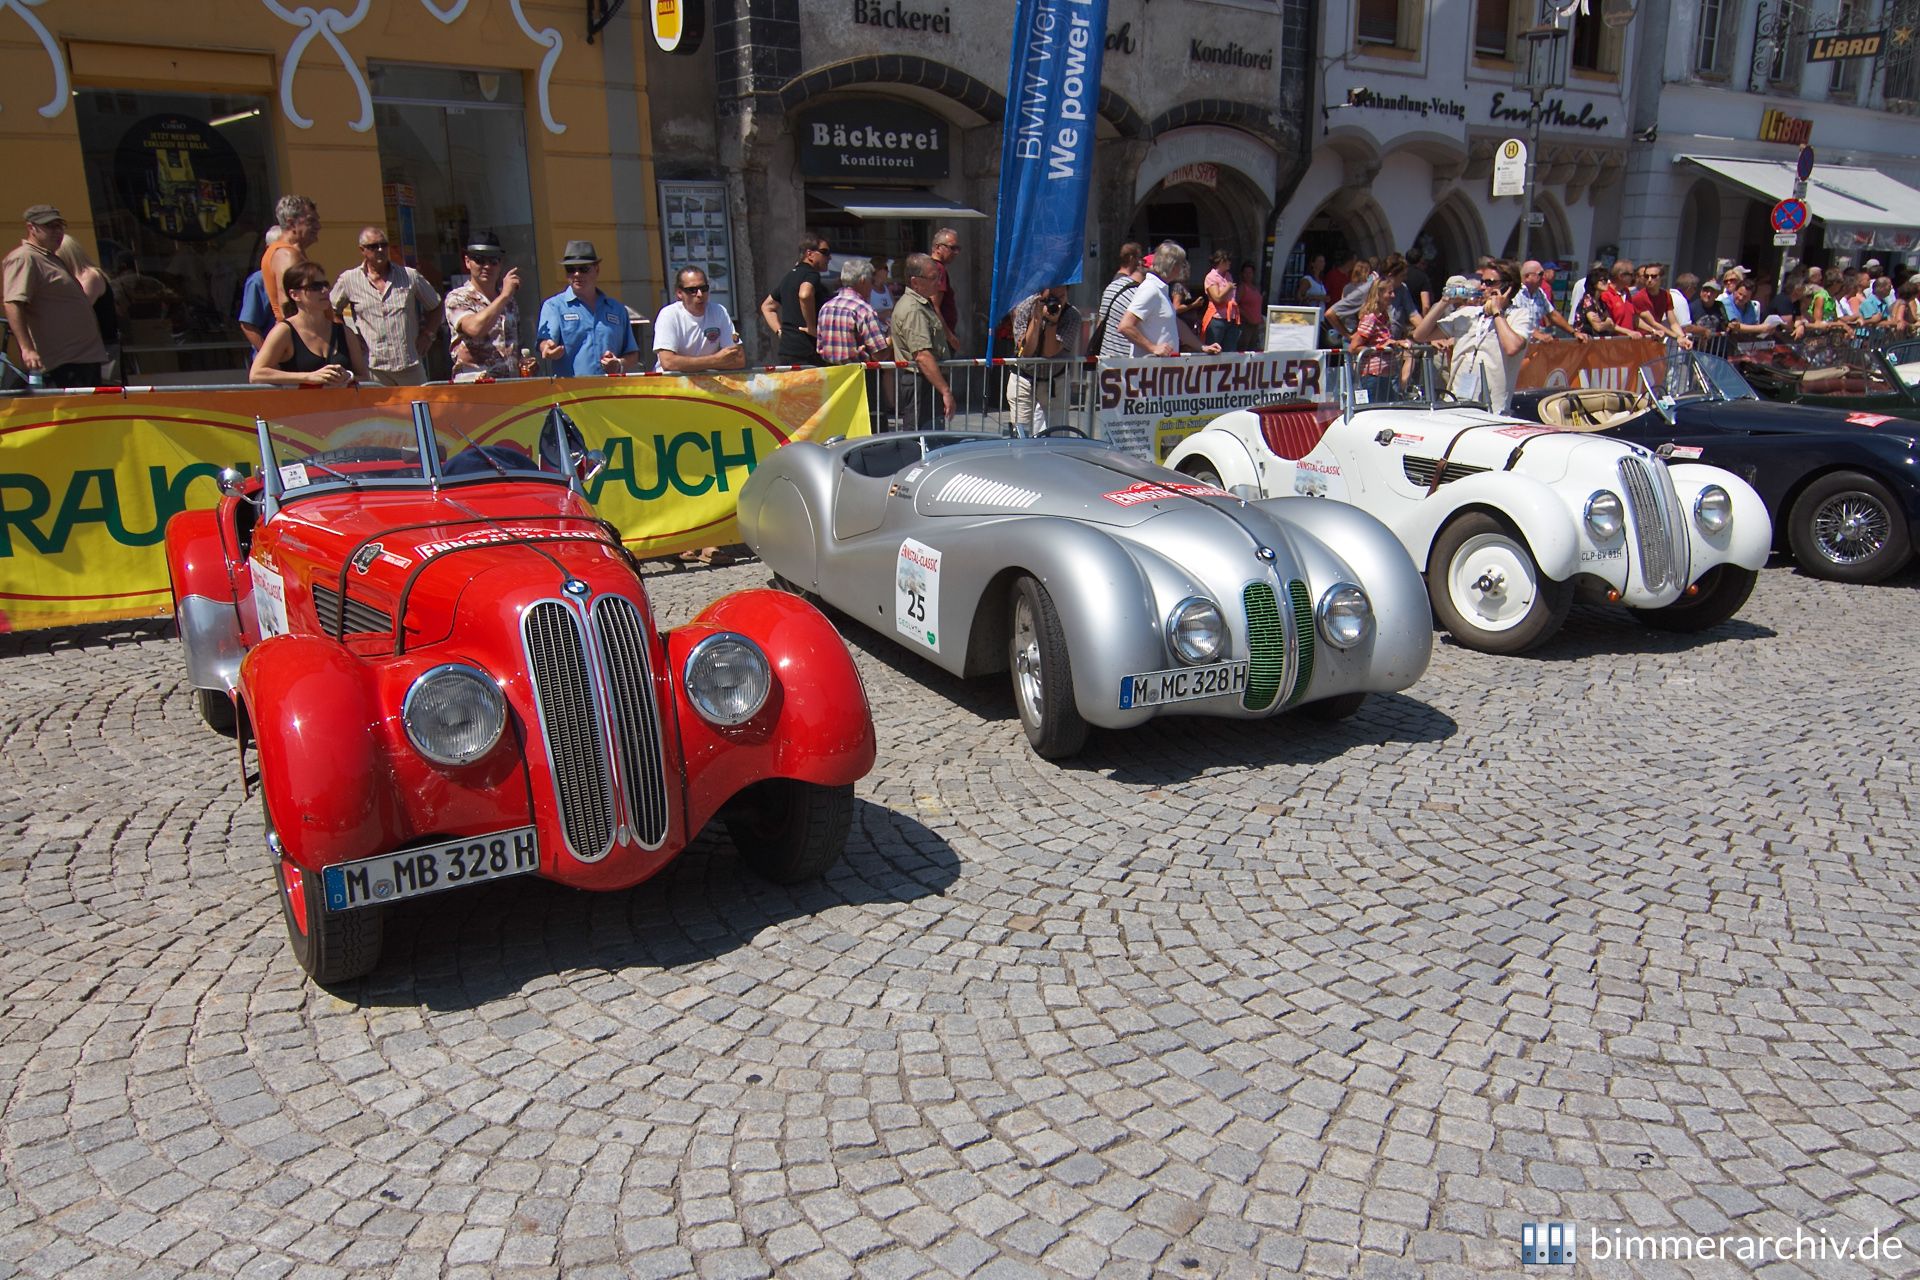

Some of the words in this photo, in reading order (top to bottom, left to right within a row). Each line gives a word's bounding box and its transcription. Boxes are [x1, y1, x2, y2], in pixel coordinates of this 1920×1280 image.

[854, 0, 950, 33] Bäckerei
[1028, 0, 1057, 62] Wer
[1061, 11, 1091, 121] power
[1190, 38, 1273, 71] Konditorei
[1016, 72, 1049, 159] BMW
[1490, 92, 1608, 131] Ennthaler
[171, 133, 185, 141] NEU
[811, 122, 939, 150] Bäckerei
[1047, 127, 1078, 180] We
[840, 154, 915, 168] Konditorei
[1101, 360, 1321, 410] SCHMUTZKILLER
[1123, 391, 1298, 417] Reinigungsunternehmen
[583, 427, 759, 506] AUCH
[0, 458, 252, 557] RAUC
[907, 589, 926, 622] 25
[1134, 678, 1148, 704] M
[1160, 674, 1187, 700] MC
[1191, 667, 1229, 695] 328
[1232, 665, 1246, 689] H
[334, 893, 343, 904] D
[346, 867, 371, 903] M
[392, 854, 439, 894] MB
[445, 839, 508, 882] 328
[513, 833, 536, 868] H
